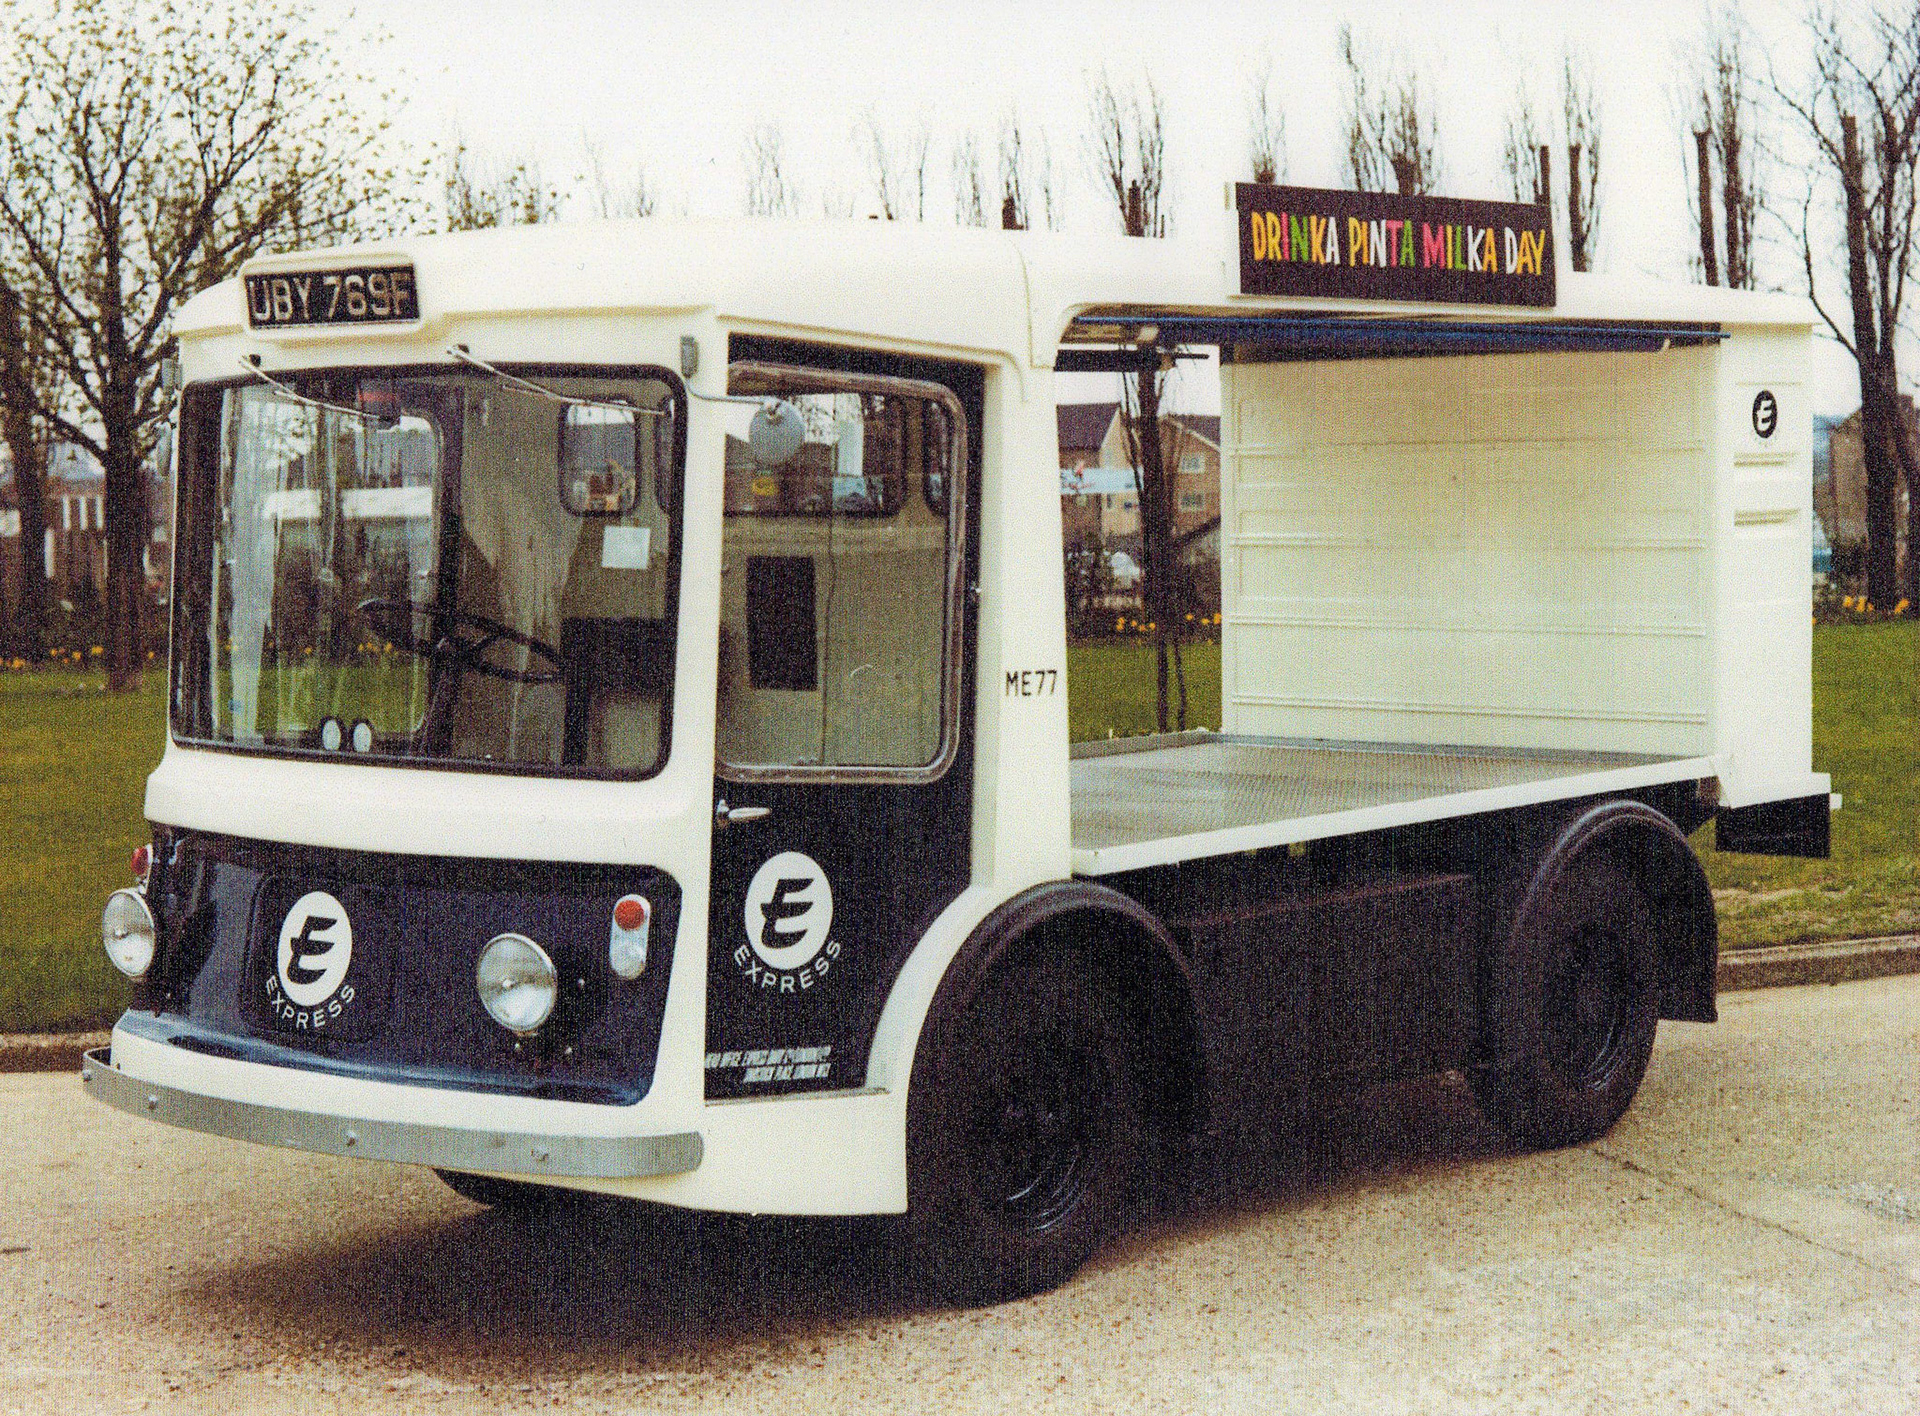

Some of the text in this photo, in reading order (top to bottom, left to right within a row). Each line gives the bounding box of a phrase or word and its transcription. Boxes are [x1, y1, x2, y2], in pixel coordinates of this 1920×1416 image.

[1251, 211, 1546, 276] DRINKA PINTA MILKA DAY
[249, 272, 412, 321] UBY 769F
[1005, 669, 1057, 697] ME77
[733, 940, 841, 993] EXPRESS
[266, 975, 355, 1030] EXPRESS
